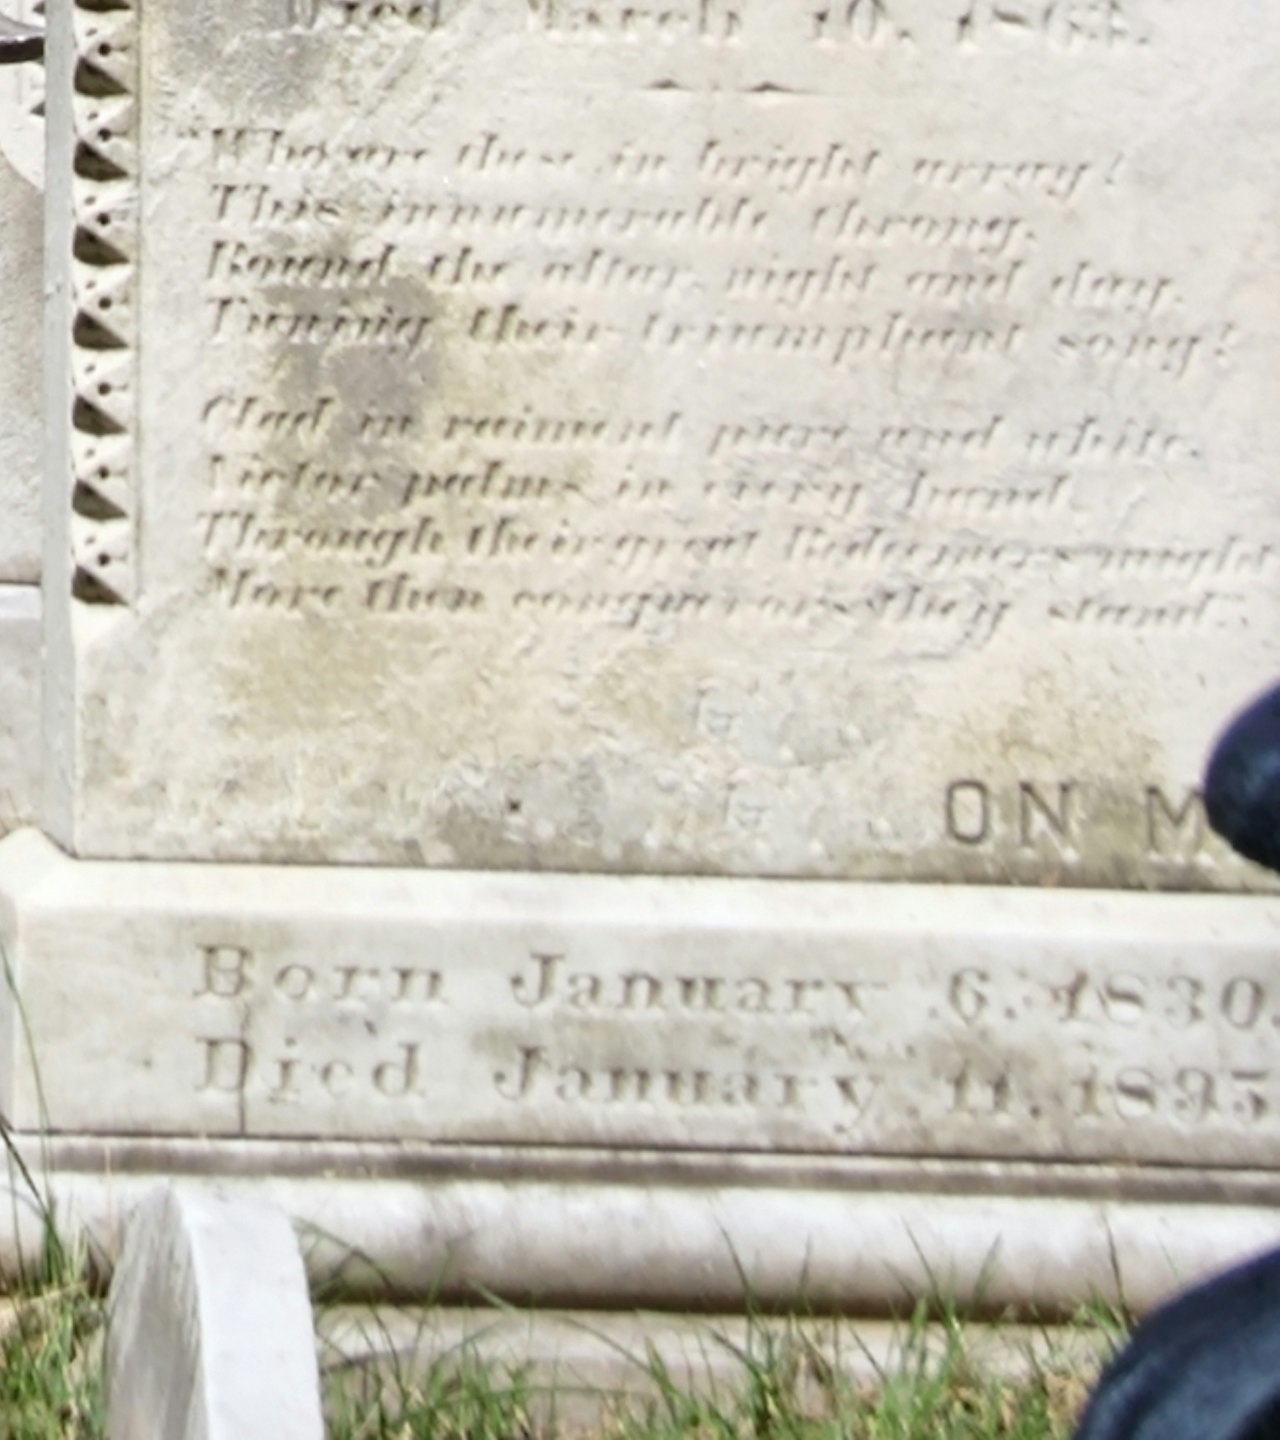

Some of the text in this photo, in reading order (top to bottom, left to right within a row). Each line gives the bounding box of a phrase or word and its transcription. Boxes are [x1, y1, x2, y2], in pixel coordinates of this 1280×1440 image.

[698, 139, 880, 194] bright
[200, 394, 333, 433] Clad
[947, 780, 1072, 846] ON
[192, 943, 449, 1006] Born
[510, 951, 887, 1018] January
[193, 1037, 425, 1105] Died
[492, 1045, 880, 1134] January
